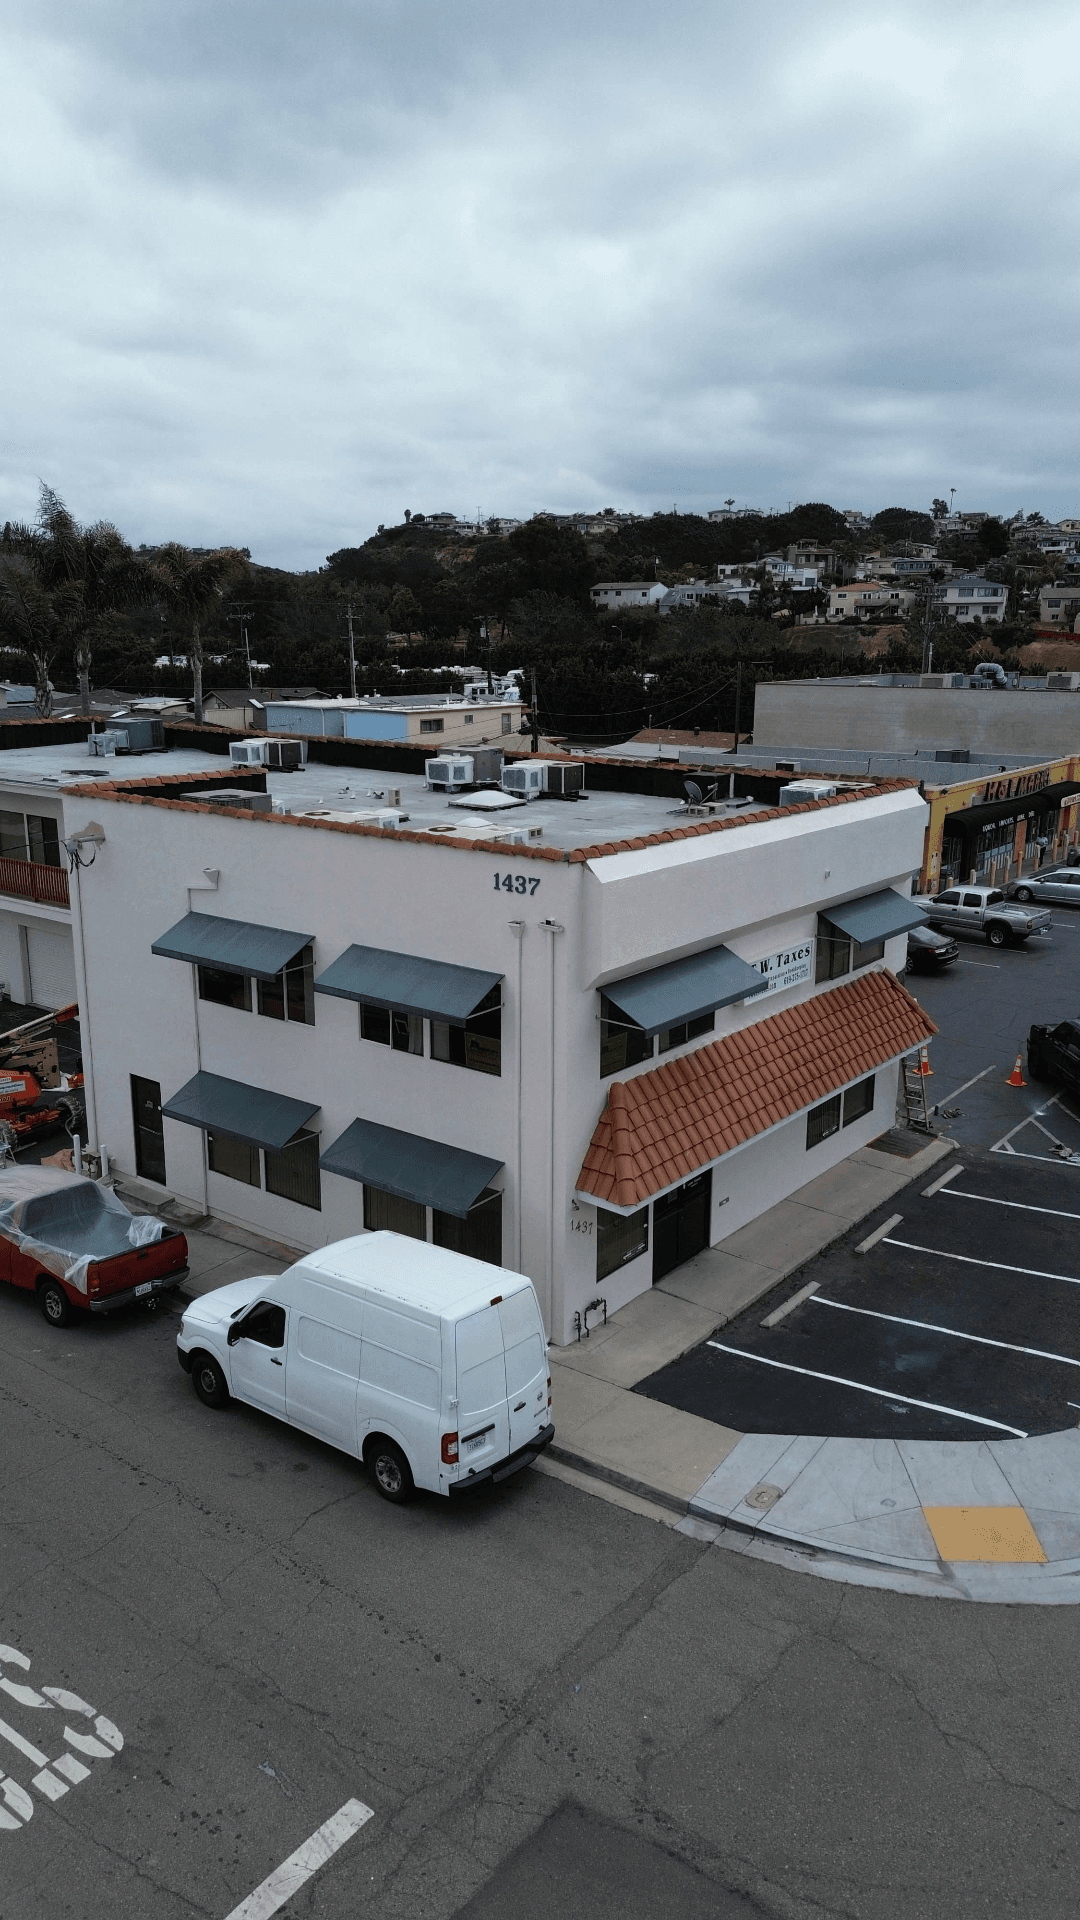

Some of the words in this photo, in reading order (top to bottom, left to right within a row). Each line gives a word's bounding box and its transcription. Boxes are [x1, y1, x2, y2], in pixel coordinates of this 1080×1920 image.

[493, 872, 541, 896] 1437
[776, 946, 810, 968] Taxes
[569, 1218, 593, 1235] 1437
